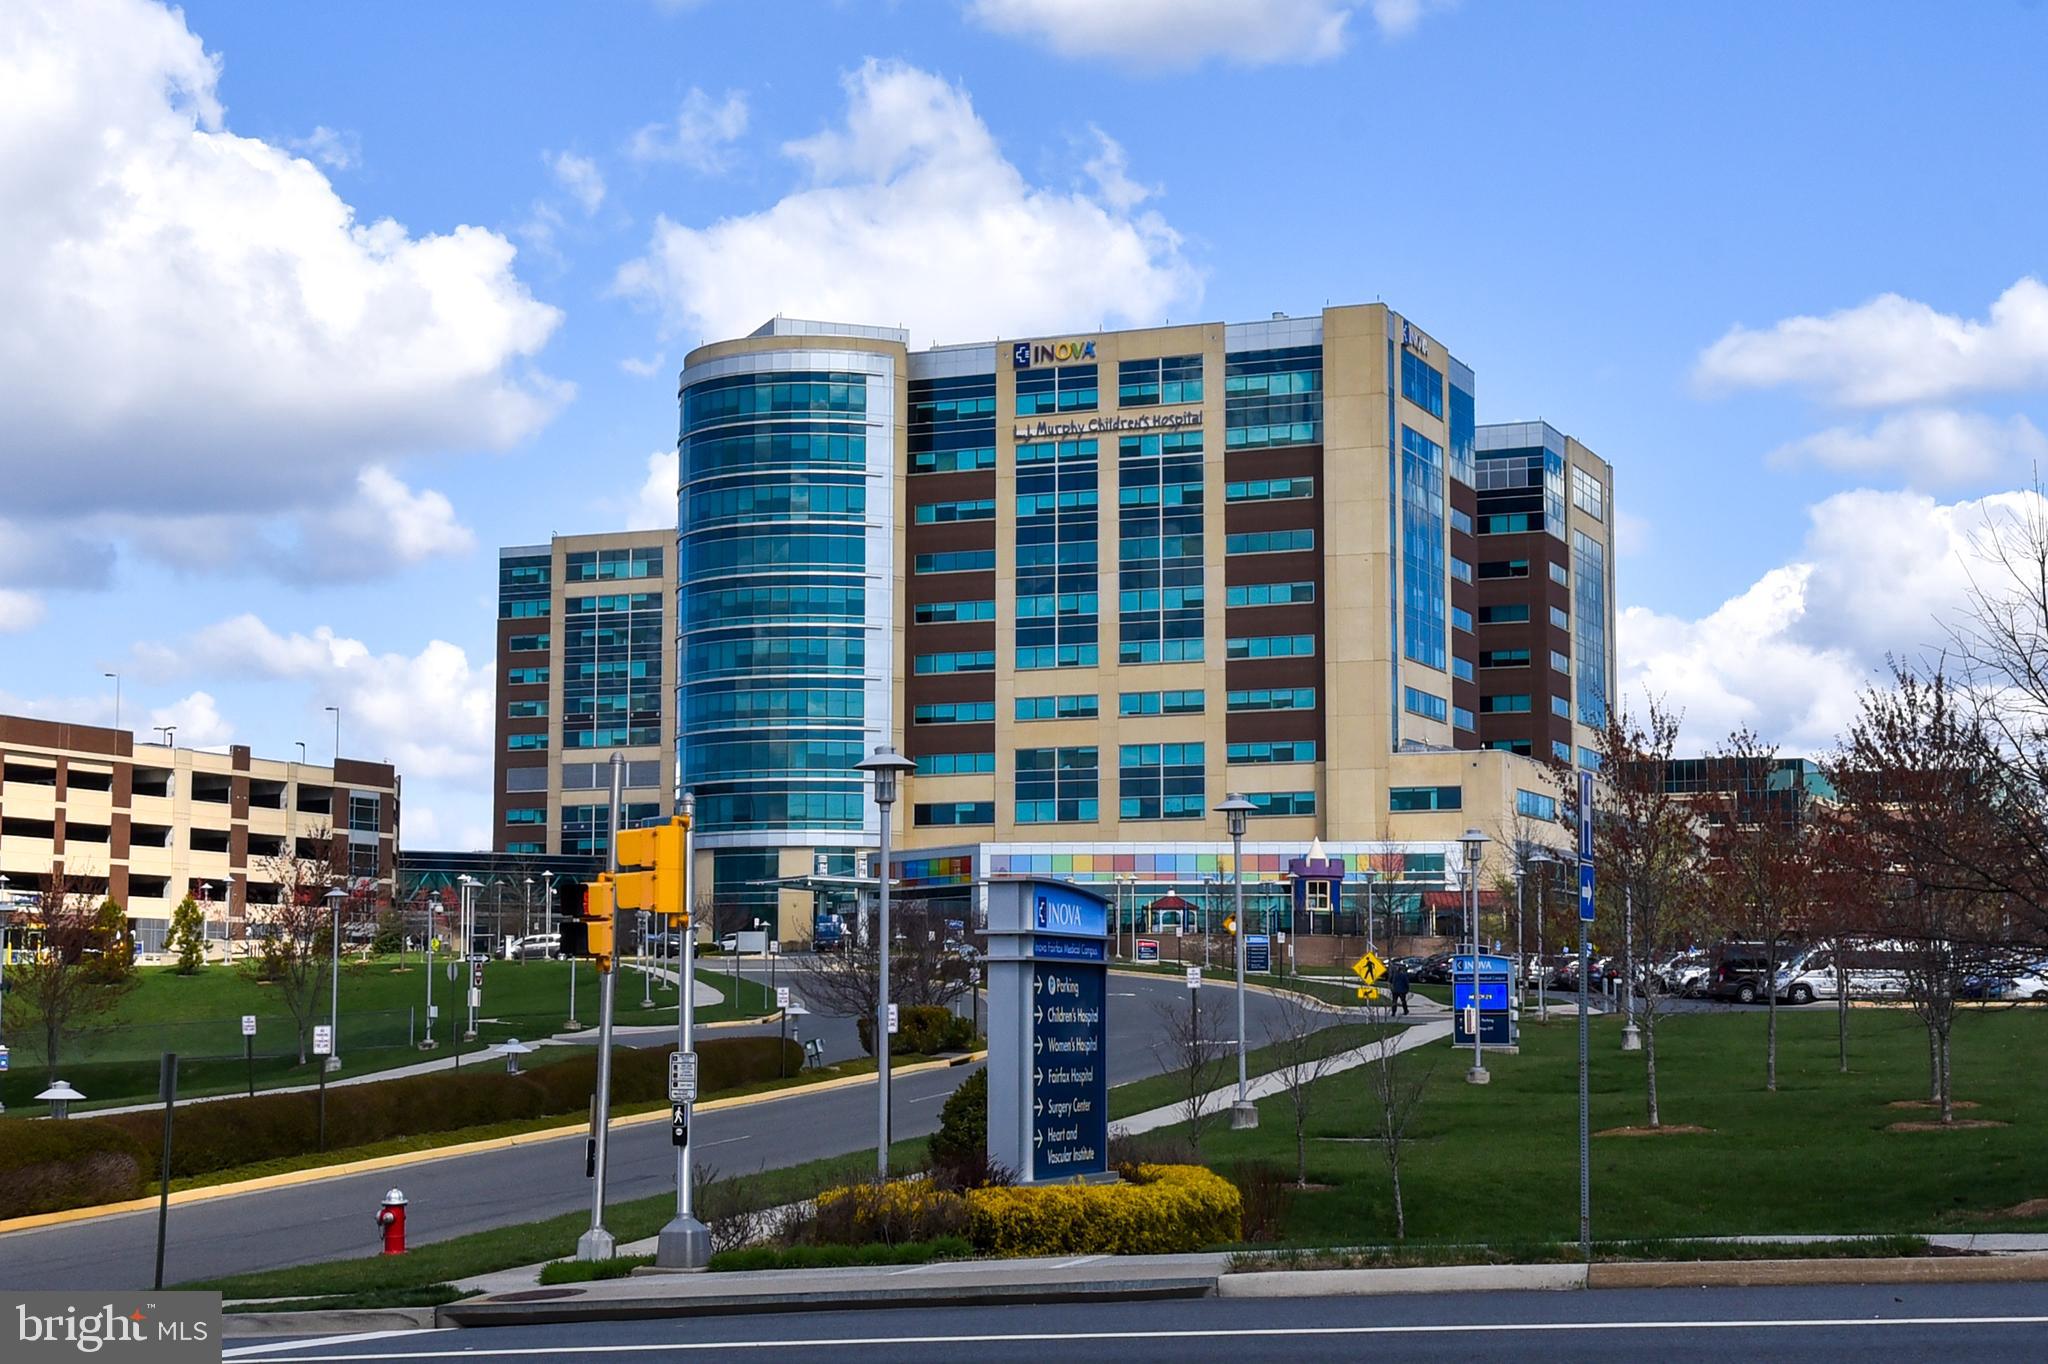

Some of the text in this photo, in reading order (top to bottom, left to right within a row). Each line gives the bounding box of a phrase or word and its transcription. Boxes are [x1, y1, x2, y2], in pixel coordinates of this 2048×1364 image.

[1034, 340, 1096, 363] INOVA
[1036, 419, 1085, 440] Murphy
[1088, 414, 1150, 433] Children's
[1152, 410, 1203, 431] Hospital
[1048, 902, 1082, 926] INOVA
[1056, 976, 1079, 998] Parking
[1047, 1006, 1099, 1027] Children's Hospital
[1047, 1035, 1098, 1056] Women's Hospital
[1048, 1065, 1093, 1086] Fairfax Hospital
[1048, 1097, 1091, 1117] Surgery Center
[1048, 1123, 1078, 1142] Heart and
[1047, 1145, 1095, 1165] Vascular Institute
